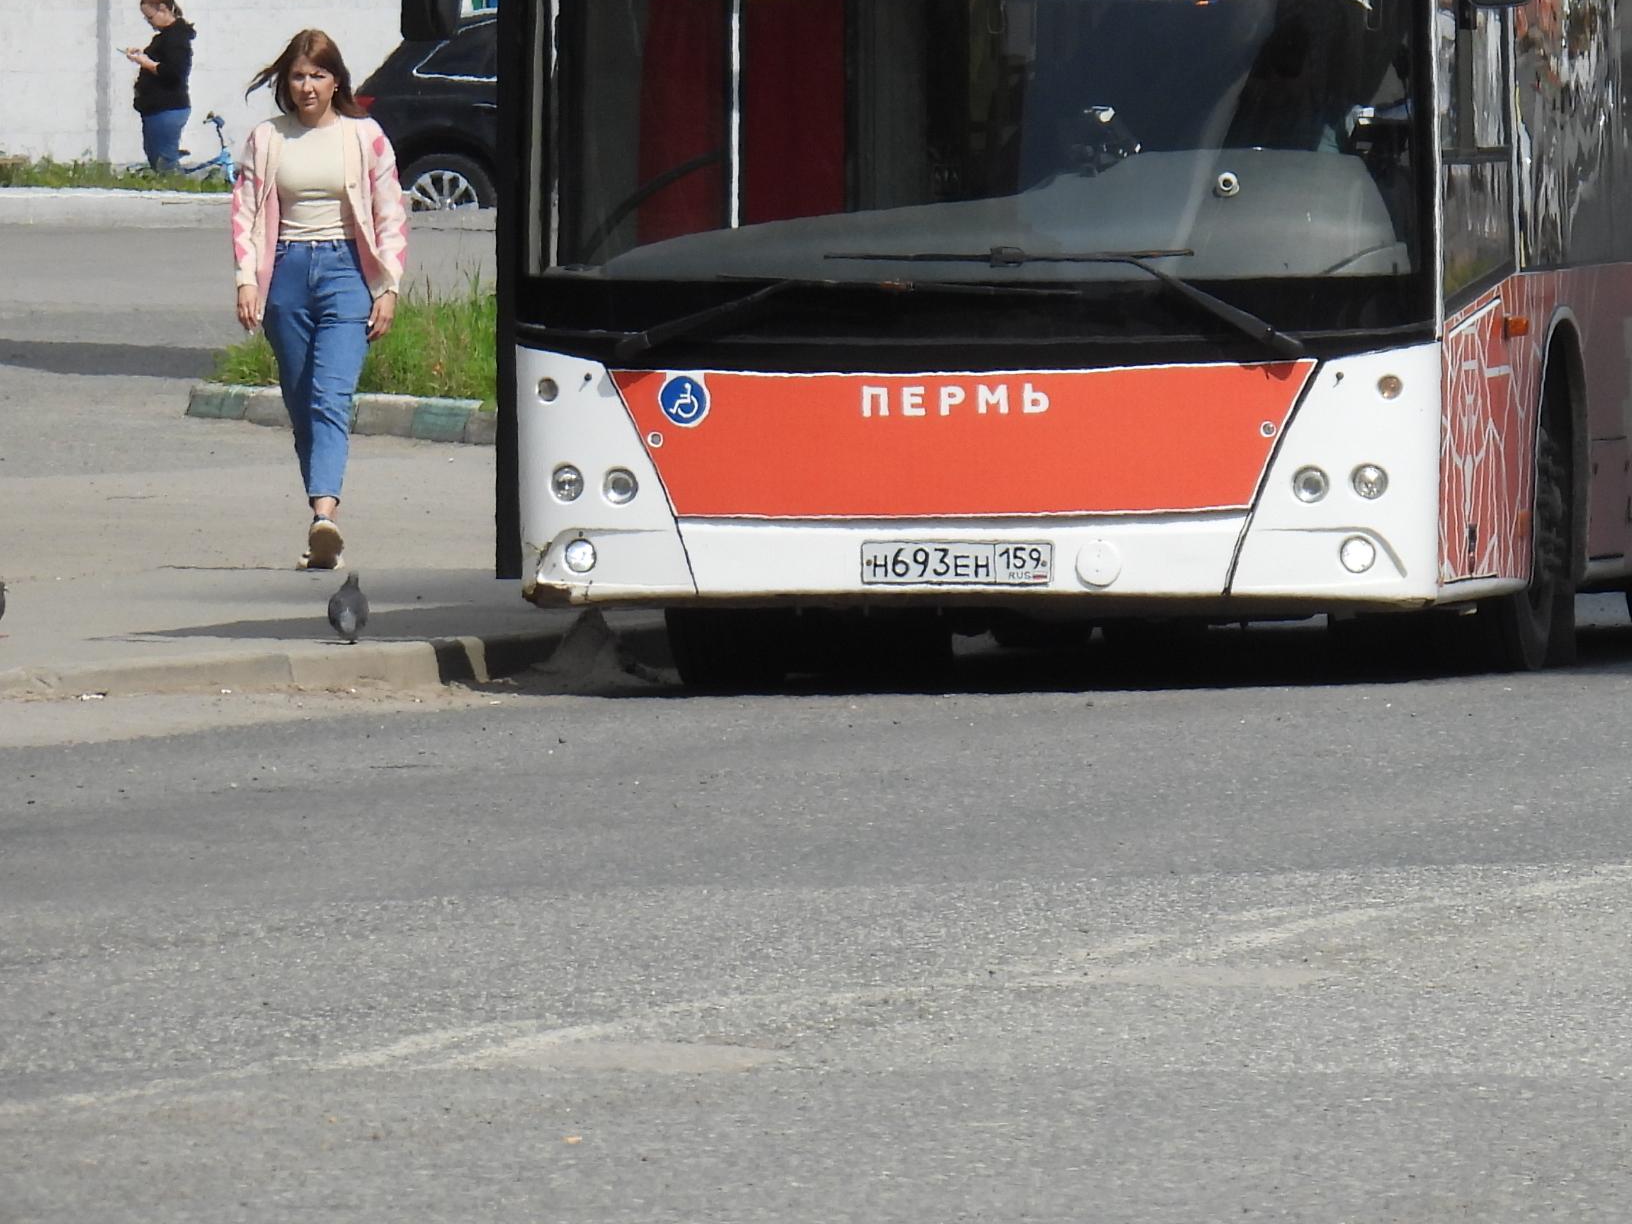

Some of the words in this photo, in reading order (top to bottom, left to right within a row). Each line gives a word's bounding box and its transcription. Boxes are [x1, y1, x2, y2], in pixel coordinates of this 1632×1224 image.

[862, 383, 1050, 417] ПЕРМЬ
[872, 547, 990, 578] Н693ЕН
[999, 546, 1041, 570] 159
[1008, 572, 1031, 580] RUS
